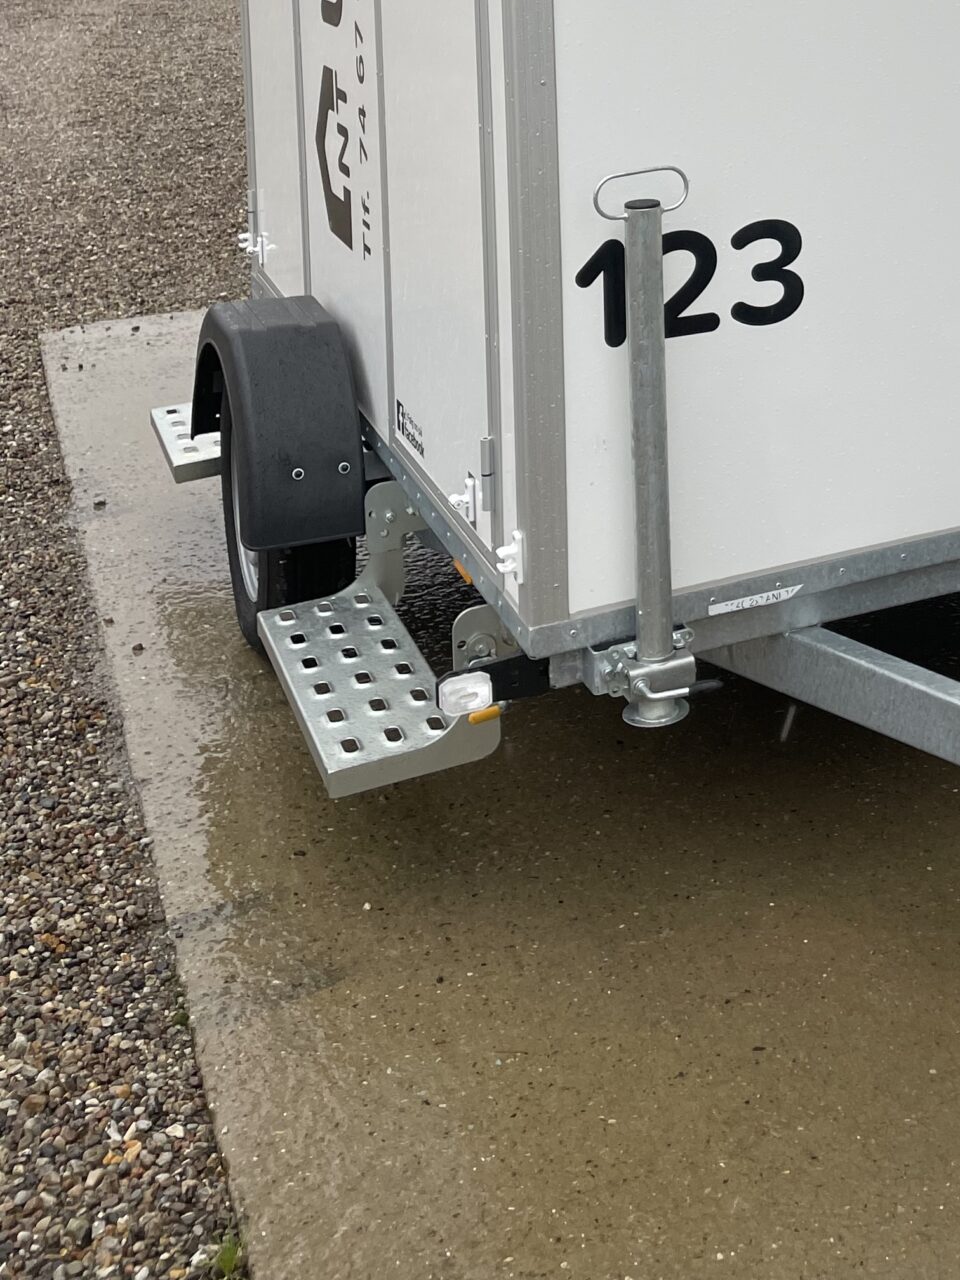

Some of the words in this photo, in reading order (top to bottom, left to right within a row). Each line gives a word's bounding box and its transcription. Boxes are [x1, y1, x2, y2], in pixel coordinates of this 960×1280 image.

[355, 20, 366, 85] 67
[358, 104, 369, 165] 74
[362, 191, 373, 261] Tlf.
[574, 218, 805, 349] 123
